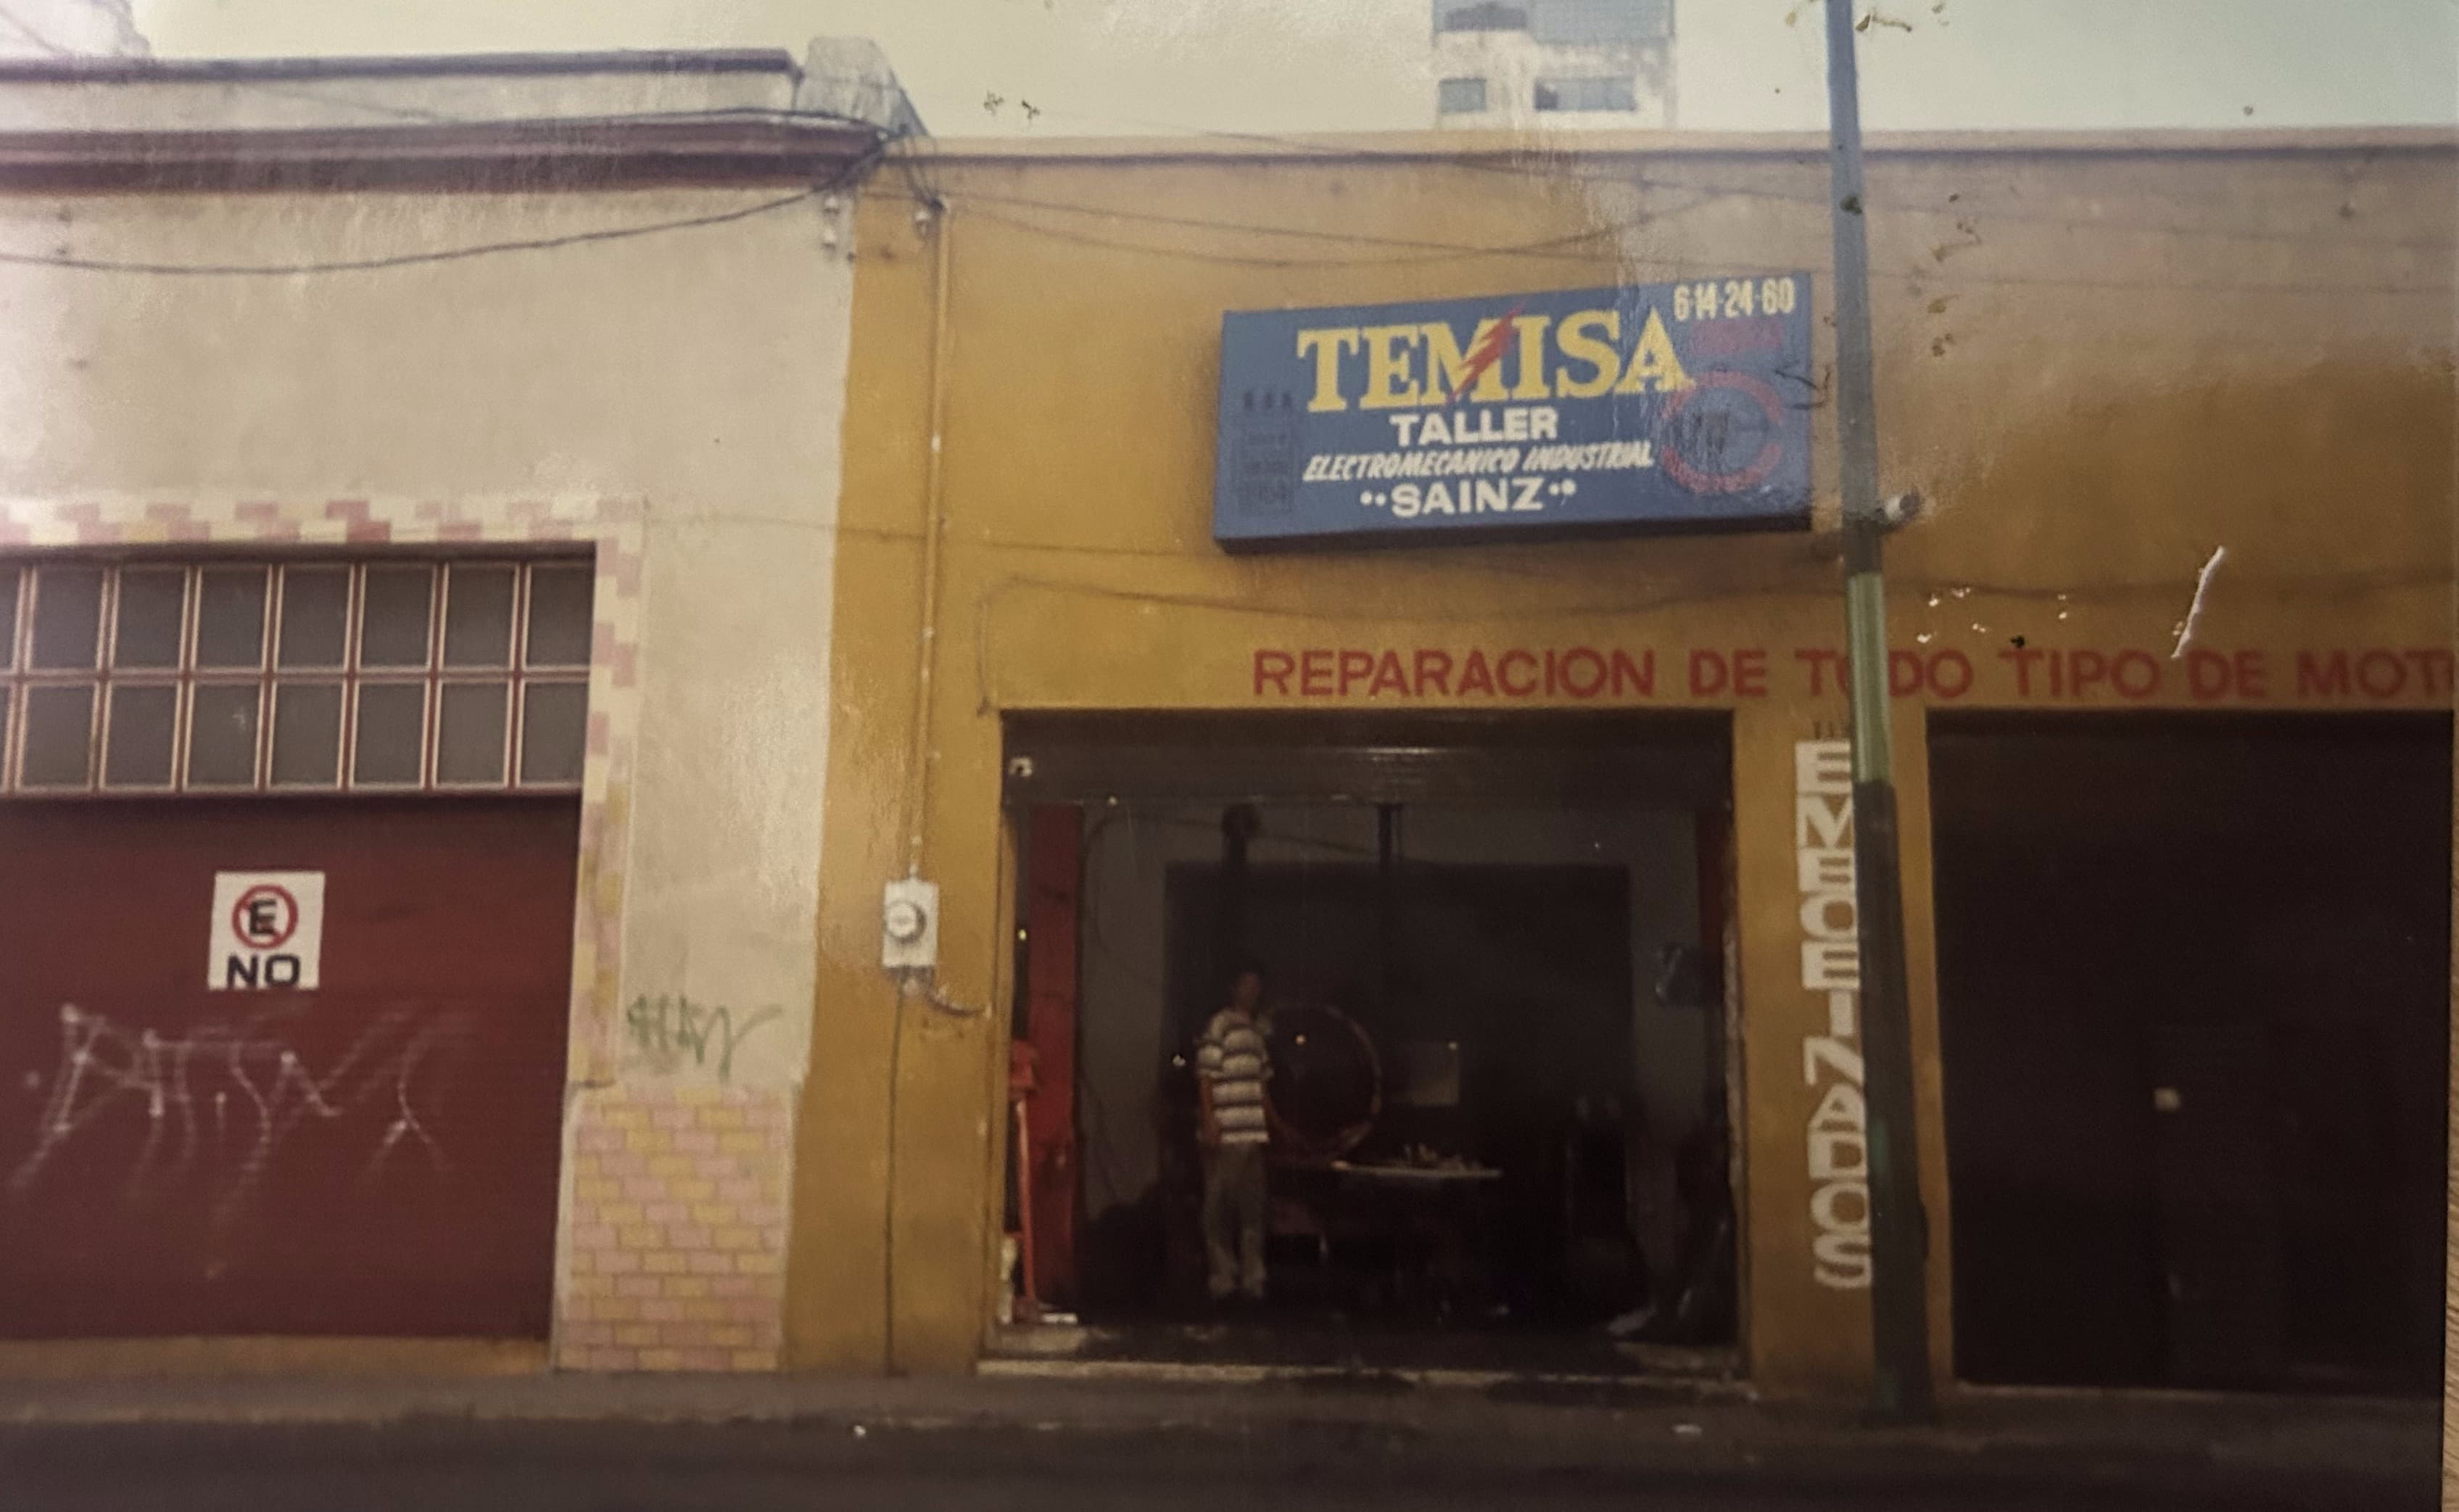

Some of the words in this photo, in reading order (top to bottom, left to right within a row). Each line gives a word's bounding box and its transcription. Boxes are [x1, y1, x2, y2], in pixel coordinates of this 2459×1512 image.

[1297, 307, 1695, 412] TEMISA
[1389, 406, 1558, 447] TALLER
[1302, 447, 1521, 482] ELECTROMECANICO
[1523, 440, 1654, 472] INDUSTRIAL
[1252, 646, 1656, 699] REPARACION
[1688, 648, 1768, 698] DE
[1999, 648, 2162, 701] TIPO
[2188, 648, 2269, 701] DE
[2296, 648, 2454, 699] MOT
[249, 898, 278, 935] E
[226, 952, 302, 987] NO
